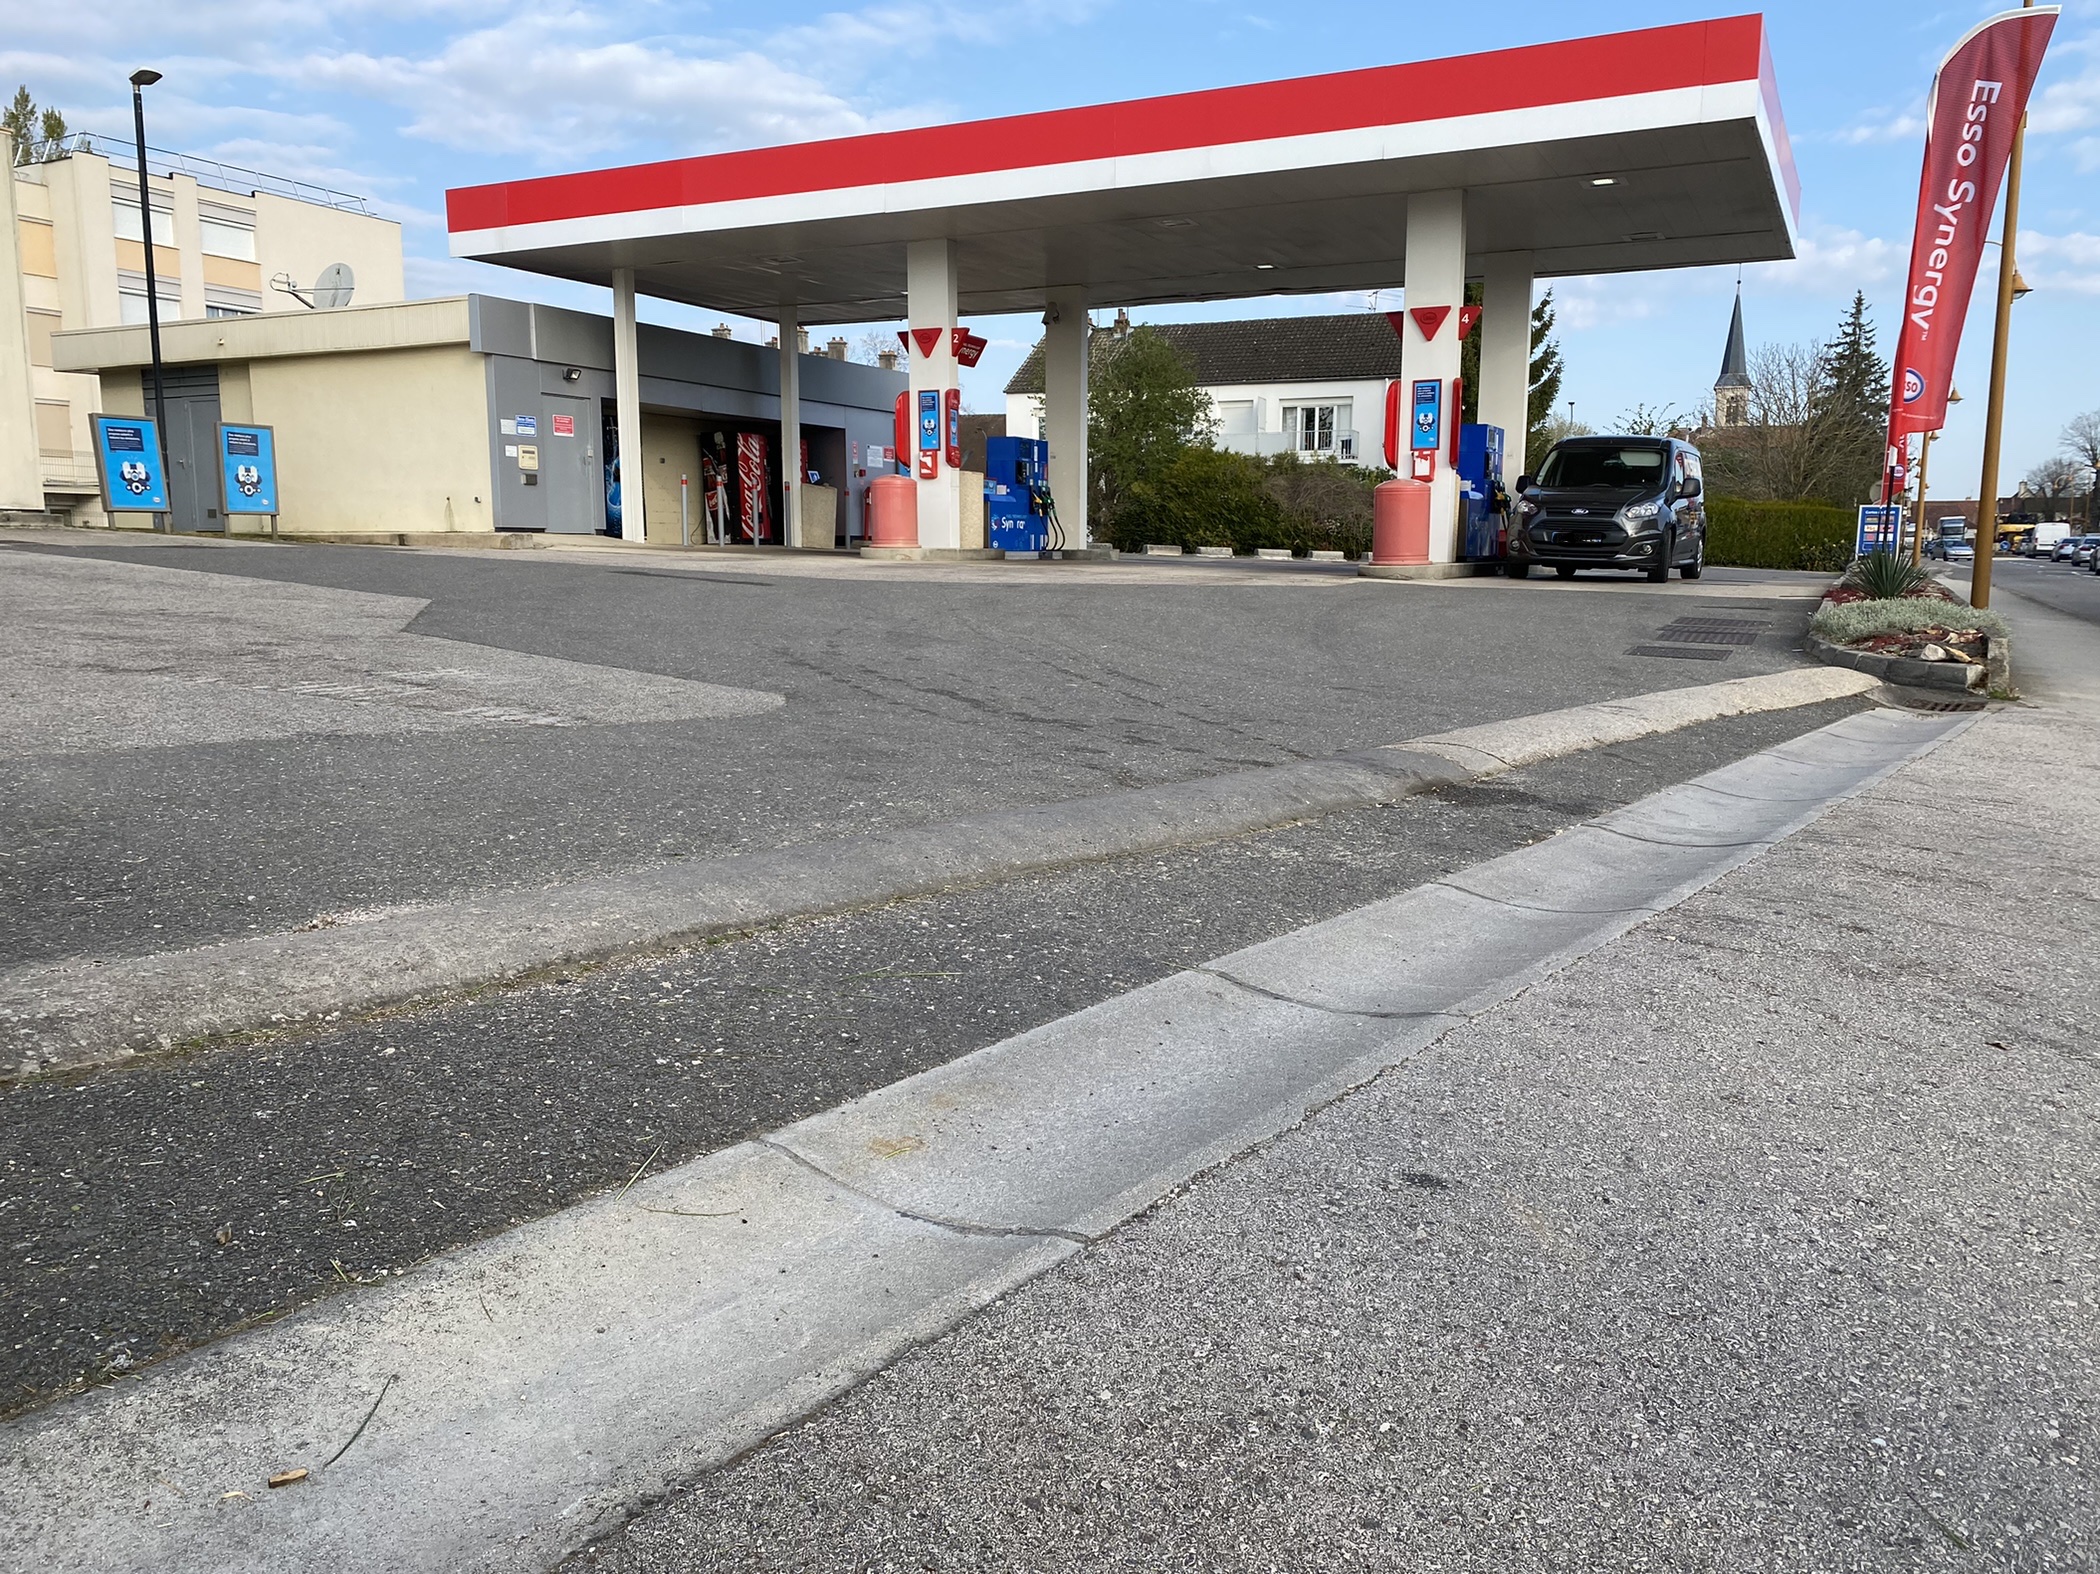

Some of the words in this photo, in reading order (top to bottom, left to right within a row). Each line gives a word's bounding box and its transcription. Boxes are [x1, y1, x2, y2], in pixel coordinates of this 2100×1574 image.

[1956, 79, 2003, 167] Esso
[1461, 313, 1469, 324] 4
[953, 334, 959, 343] 2
